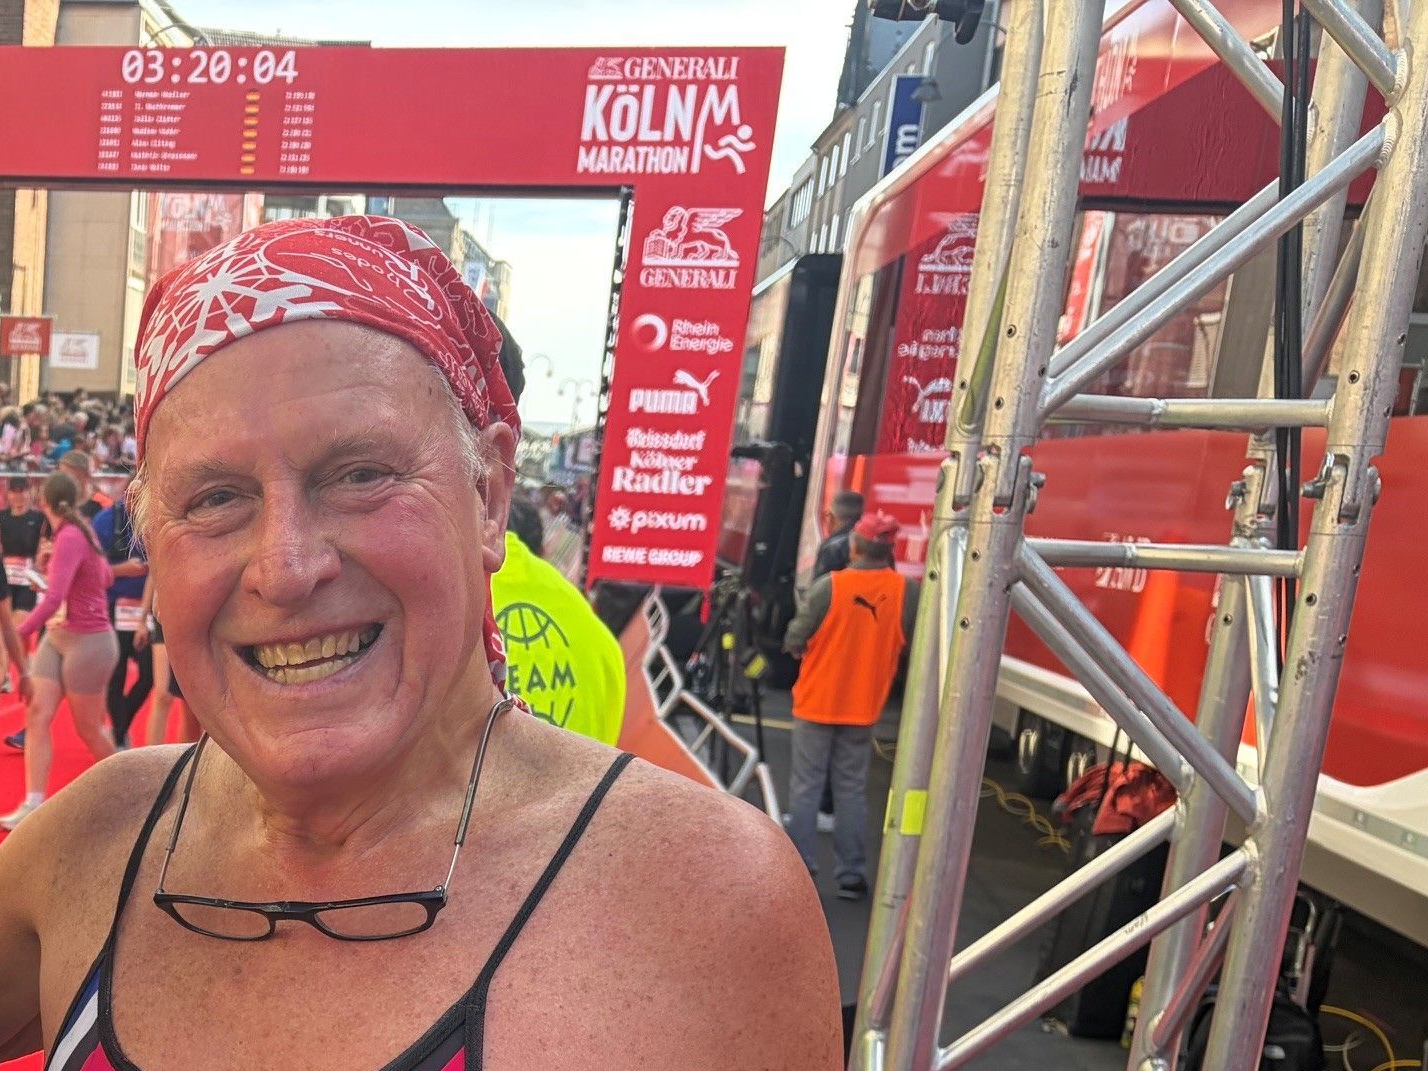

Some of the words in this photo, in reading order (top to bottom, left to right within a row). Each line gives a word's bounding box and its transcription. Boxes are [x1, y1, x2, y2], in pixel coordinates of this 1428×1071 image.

[122, 49, 298, 84] 03:20:04
[624, 56, 740, 80] GENERALI
[580, 83, 698, 142] KÖLN
[577, 145, 690, 174] MARATHON
[639, 267, 738, 289] GENERALI
[672, 319, 720, 336] Rhein
[670, 336, 734, 355] Energie
[628, 388, 698, 415] PUMA
[629, 450, 698, 471] Kölner
[611, 466, 714, 496] Radler
[630, 510, 708, 535] pixum
[648, 548, 704, 567] GROUP
